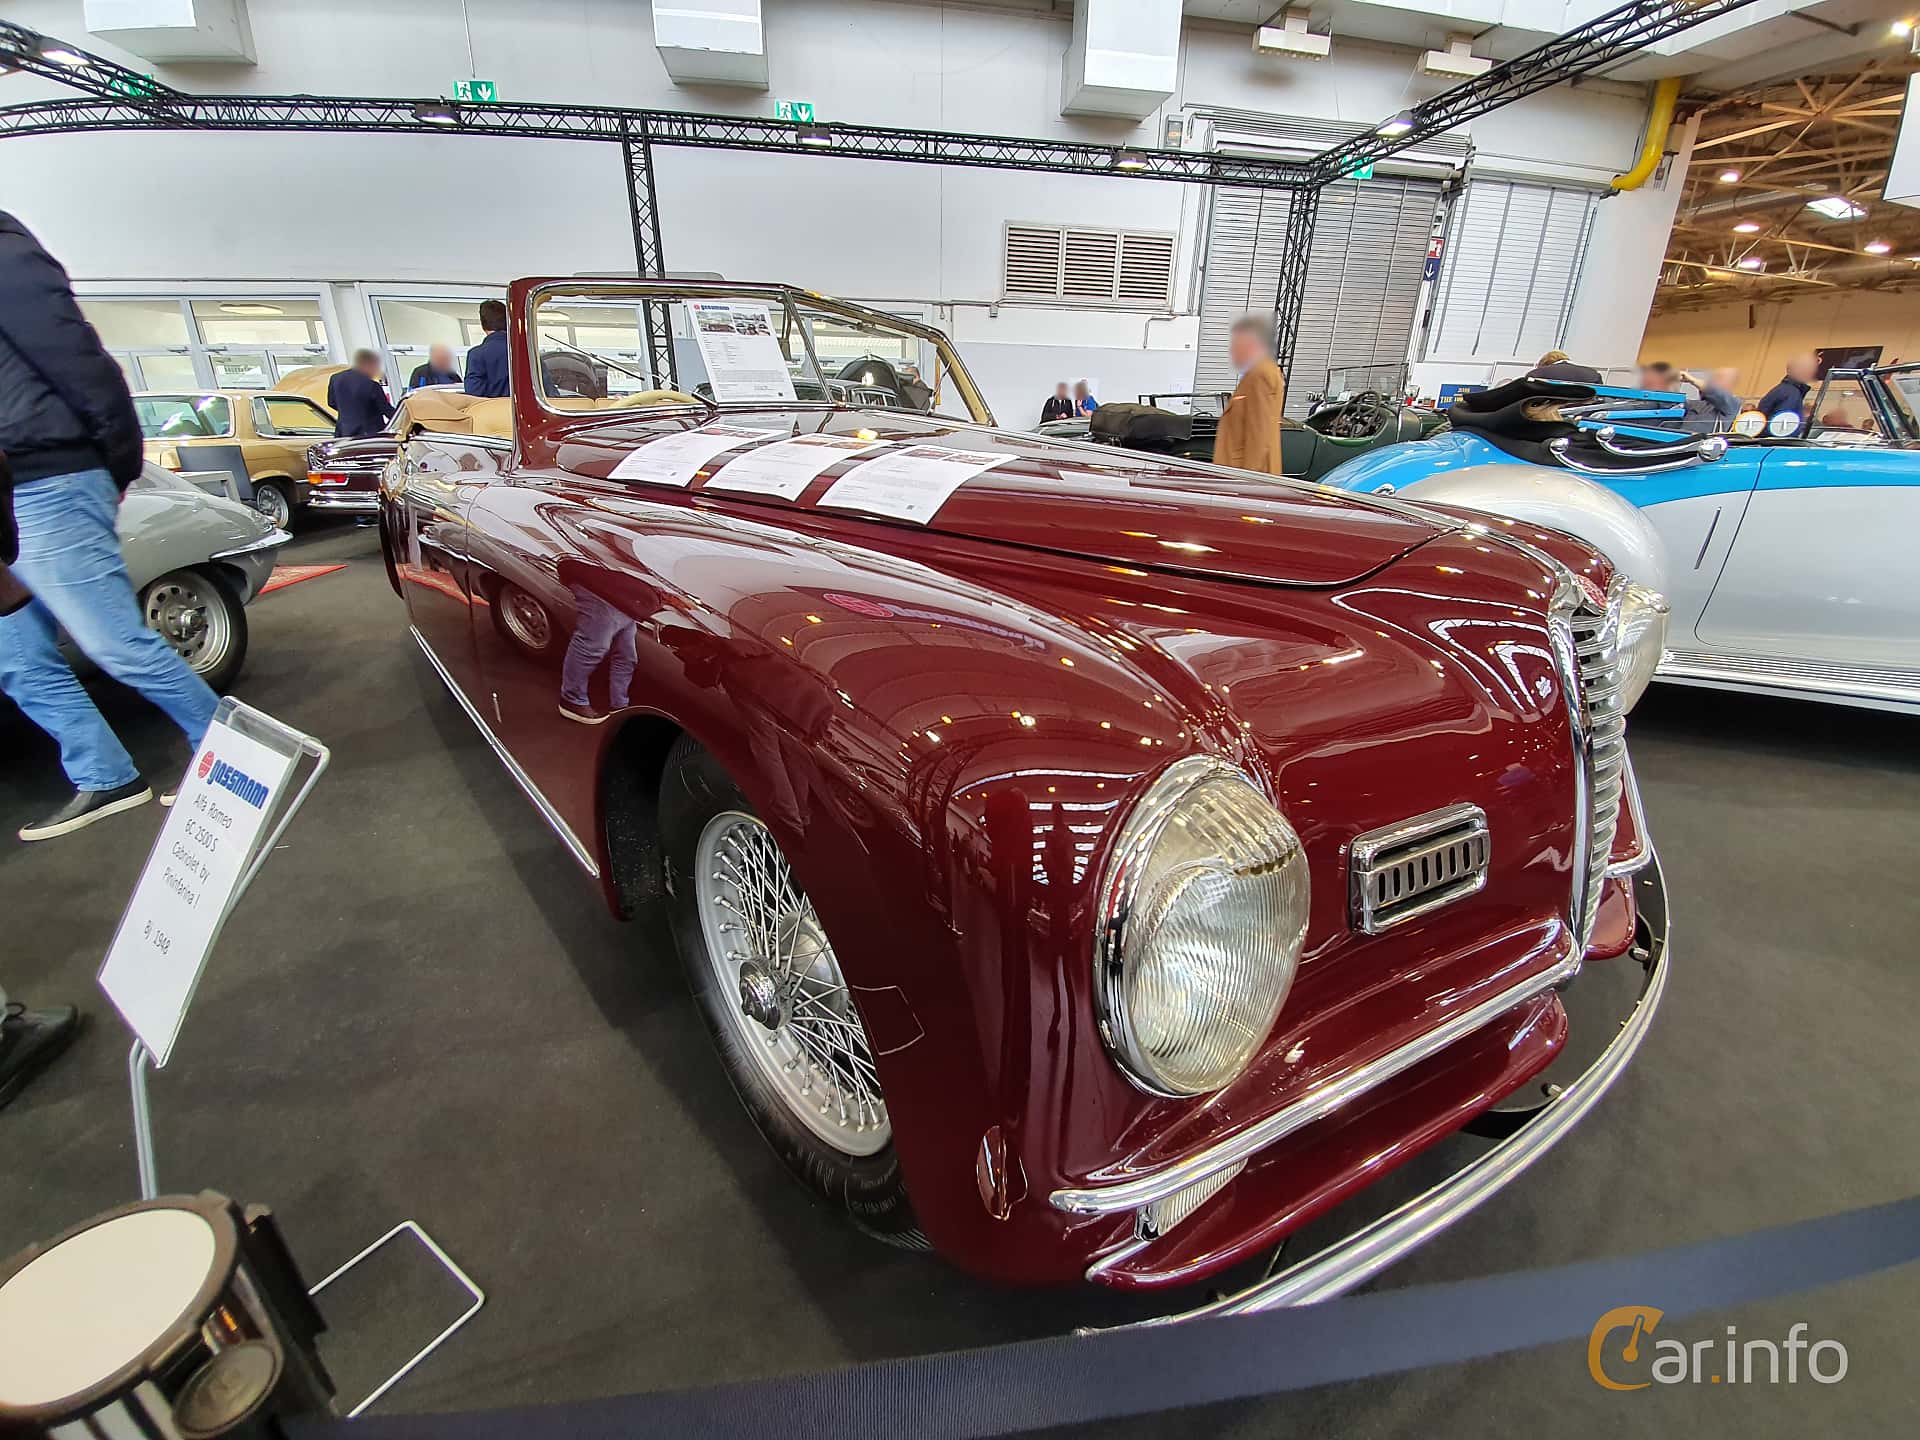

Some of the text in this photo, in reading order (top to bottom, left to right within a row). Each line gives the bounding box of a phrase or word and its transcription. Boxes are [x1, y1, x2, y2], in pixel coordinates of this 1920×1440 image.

[185, 818, 196, 836] 6C
[193, 792, 232, 829] Alfa Romeo
[172, 841, 211, 885] Cabriolet by
[163, 866, 195, 905] Pininfarina
[153, 929, 171, 955] 1948
